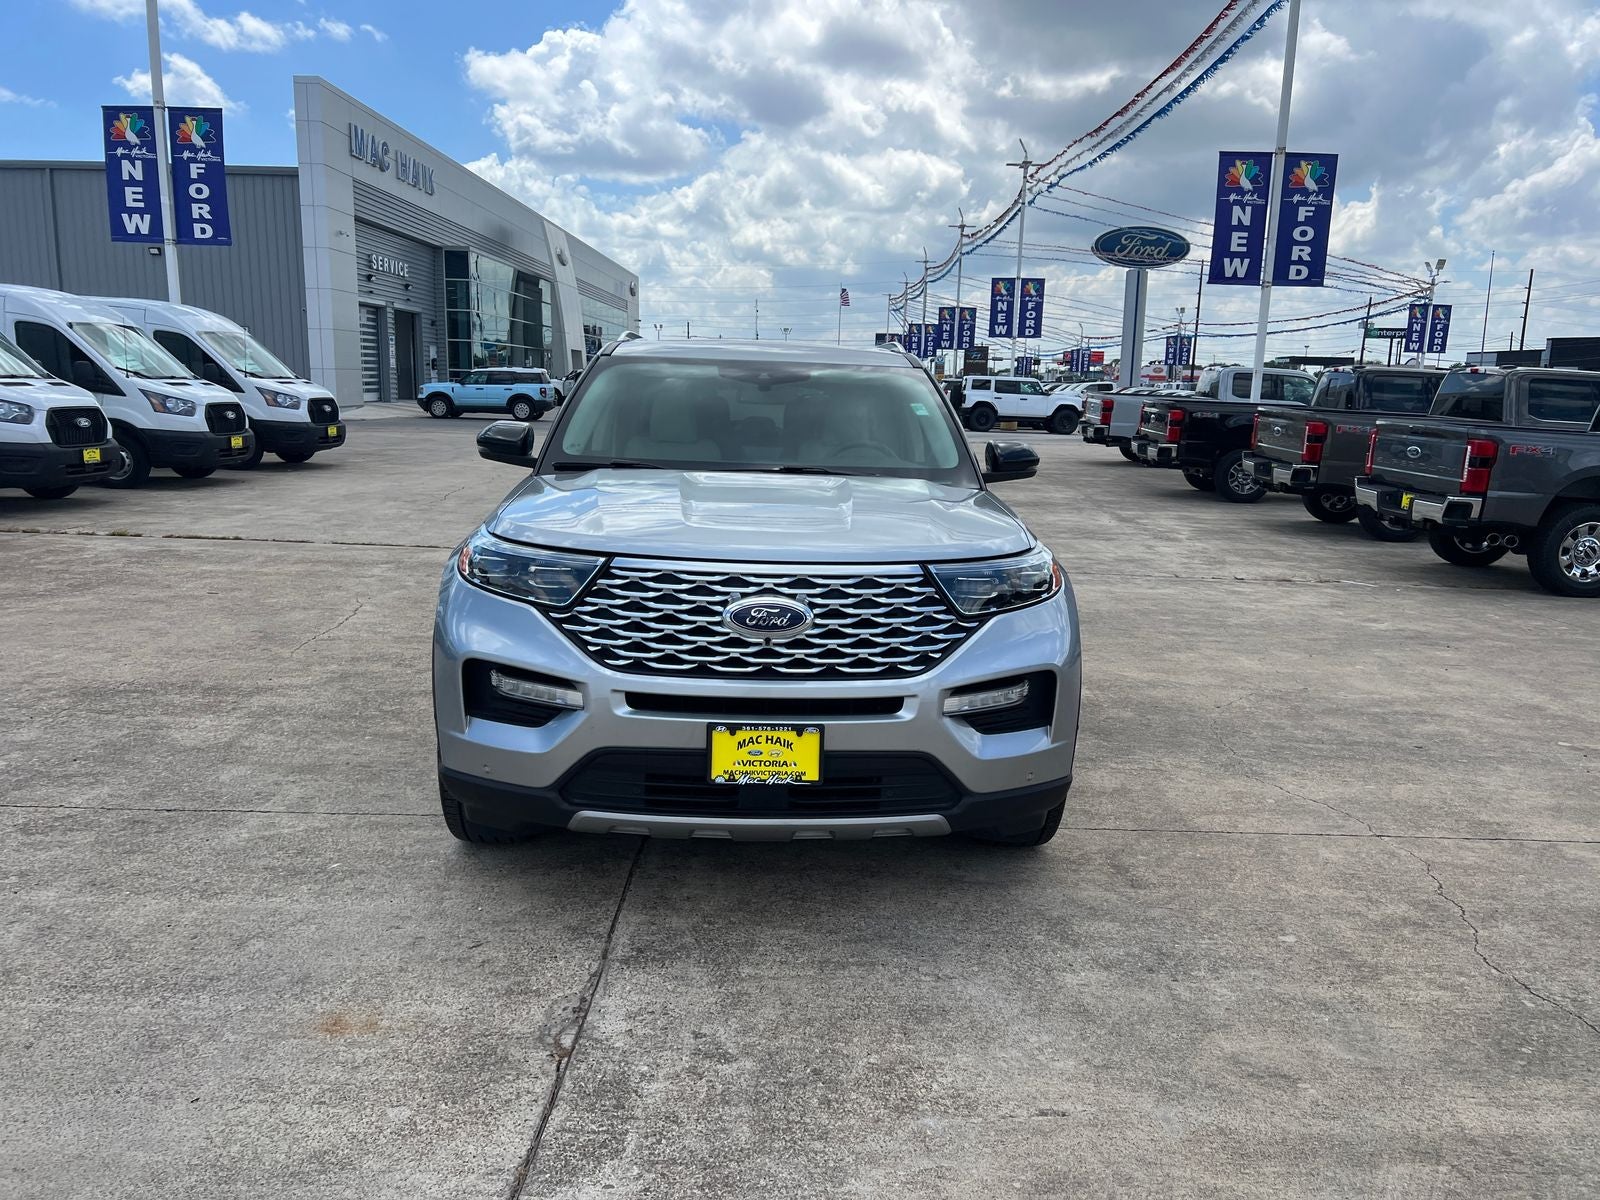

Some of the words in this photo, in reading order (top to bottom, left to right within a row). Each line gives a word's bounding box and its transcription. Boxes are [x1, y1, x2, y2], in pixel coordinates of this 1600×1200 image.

[348, 122, 391, 173] MAC
[121, 159, 151, 235] NEW
[188, 163, 214, 239] FORD
[1114, 233, 1171, 260] Ford
[1223, 205, 1252, 278] NEW
[1287, 206, 1316, 280] FORD
[371, 254, 409, 278] SERVICE
[994, 301, 1008, 335] NEW
[1025, 302, 1036, 336] FORD
[941, 323, 951, 348] NEW
[962, 323, 971, 349] FORD
[1409, 323, 1421, 351] NEW
[1432, 323, 1444, 352] FORD
[1167, 347, 1175, 365] NEW
[1509, 444, 1554, 457] FX4
[746, 607, 792, 626] Ford
[736, 734, 763, 751] MAC
[765, 734, 794, 752] HAIK
[741, 759, 789, 768] VICTORIA
[736, 773, 764, 785] Mac
[765, 773, 797, 785] Haik
